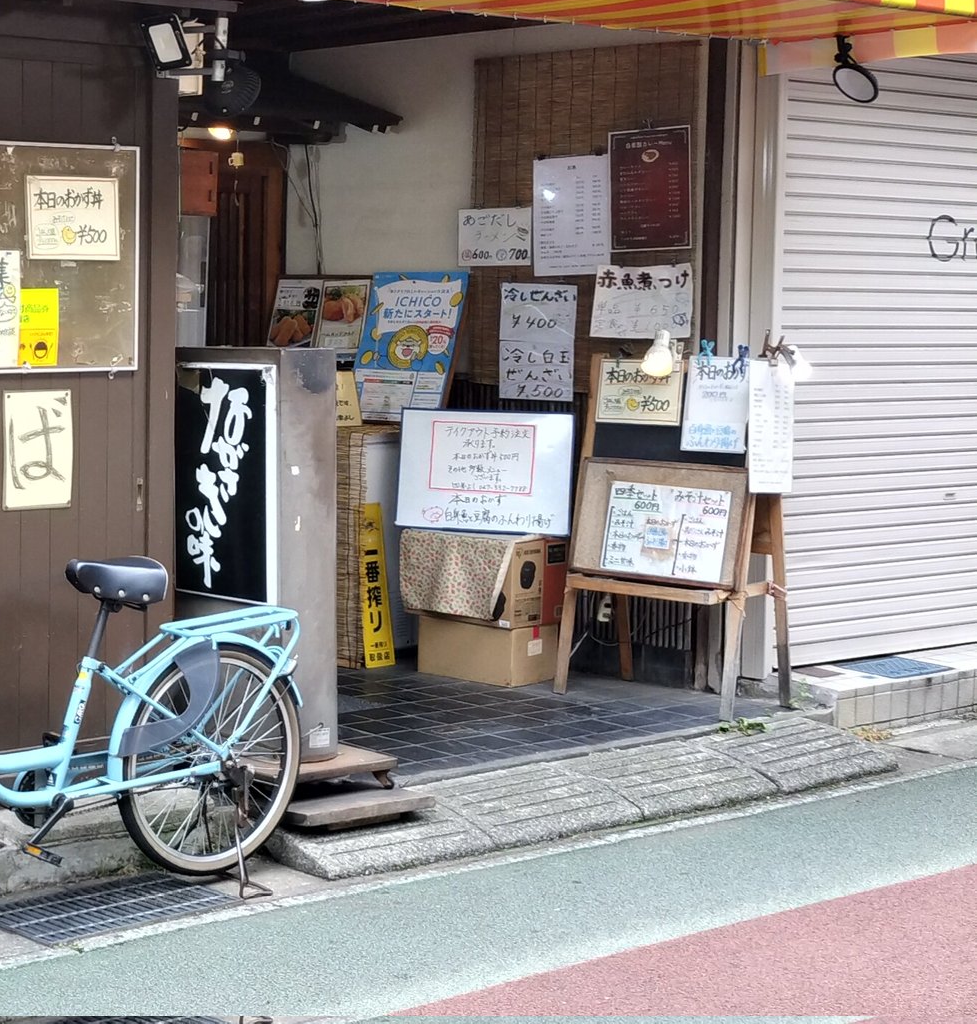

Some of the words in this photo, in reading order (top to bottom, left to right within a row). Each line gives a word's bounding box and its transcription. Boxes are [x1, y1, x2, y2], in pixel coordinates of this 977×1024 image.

[33, 187, 103, 210] 本日のおかず丼
[463, 214, 517, 228] あごだし
[597, 269, 690, 291] 赤魚煮つけ
[395, 296, 442, 307] ICHICO
[502, 347, 571, 364] 冷し白玉
[506, 367, 573, 383] ぜんざい
[364, 549, 383, 633] 一番搾り
